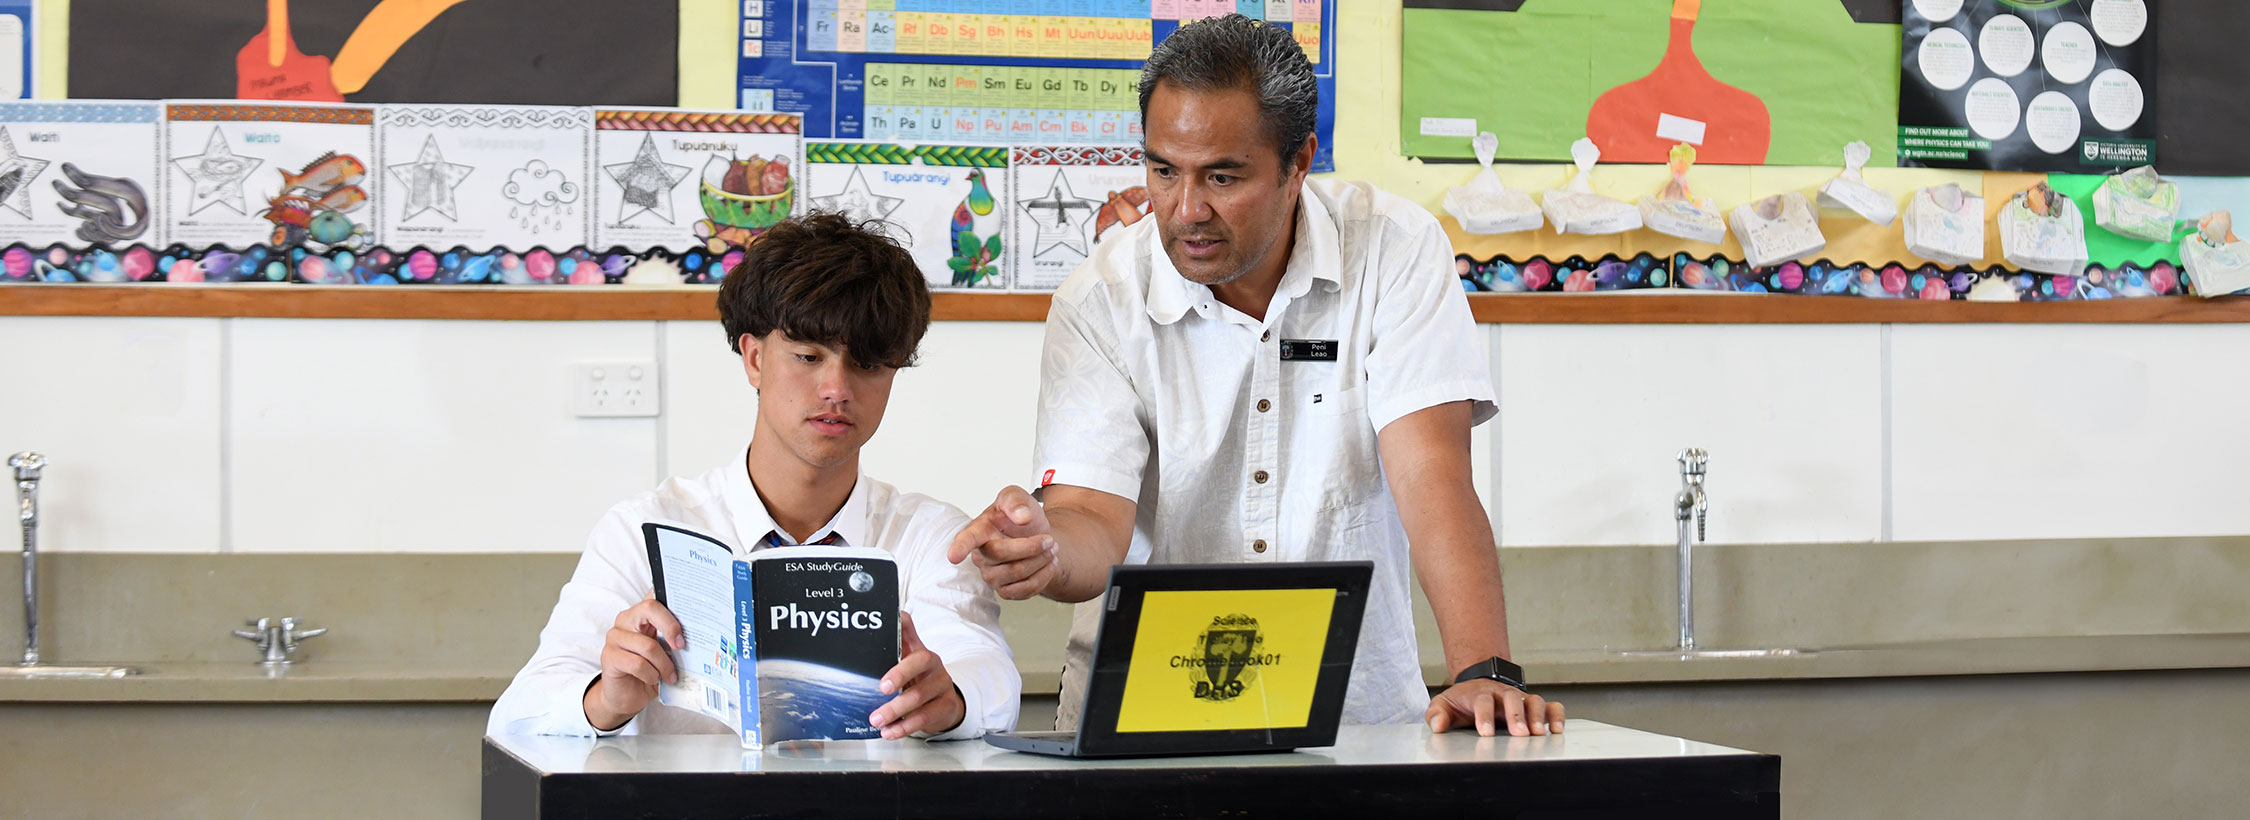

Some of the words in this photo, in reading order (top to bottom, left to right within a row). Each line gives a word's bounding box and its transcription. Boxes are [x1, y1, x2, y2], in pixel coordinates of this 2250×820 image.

[816, 21, 830, 32] Fr
[844, 21, 860, 33] Ra
[903, 23, 917, 34] Rf
[930, 24, 948, 35] Db
[959, 25, 976, 38] Sg
[987, 25, 1005, 37] Bh
[1016, 26, 1033, 38] Hs
[1045, 27, 1061, 39] Mt
[1068, 28, 1094, 39] Uun
[1097, 28, 1123, 40] Uuu
[1125, 29, 1151, 41] Uub
[871, 75, 888, 86] Ce
[902, 76, 916, 87] Pr
[928, 77, 946, 88] Nd
[955, 77, 977, 89] Pm
[984, 78, 1006, 89] Sm
[1016, 79, 1032, 90] Eu
[1043, 79, 1062, 91] Gd
[1073, 80, 1088, 92] Tb
[1101, 81, 1117, 94] Dy
[872, 117, 887, 128] Th
[900, 118, 916, 129] Pa
[931, 119, 941, 129] U
[956, 119, 974, 132] Np
[985, 120, 1002, 131] Pu
[1011, 121, 1033, 132] Am
[1040, 121, 1062, 132] Cm
[1071, 121, 1088, 133] Bk
[1102, 122, 1116, 133] Cf
[1905, 127, 1919, 135] FIND
[1919, 128, 1931, 136] OUT
[1932, 128, 1948, 136] MORE
[1949, 129, 1968, 137] ABOUT
[1904, 138, 1924, 146] WHERE
[1925, 139, 1949, 147] PHYSICS
[1962, 140, 1976, 148] TAKE
[1911, 150, 1966, 159] wgtn.ac.nz/science
[2100, 147, 2147, 156] WELLINGTON
[689, 549, 718, 567] Physics
[785, 562, 805, 572] ESA
[807, 562, 864, 573] StudyGuide
[805, 587, 833, 598] Level
[837, 589, 844, 598] 3
[741, 600, 749, 617] Level
[770, 603, 883, 637] Physics
[1213, 615, 1257, 626] Science
[739, 622, 752, 660] Physics
[1199, 634, 1235, 646] Tolley
[1240, 633, 1264, 644] To
[1170, 653, 1281, 668] Chromeook01
[1194, 680, 1245, 698] DHS
[845, 726, 868, 734] Pauline
